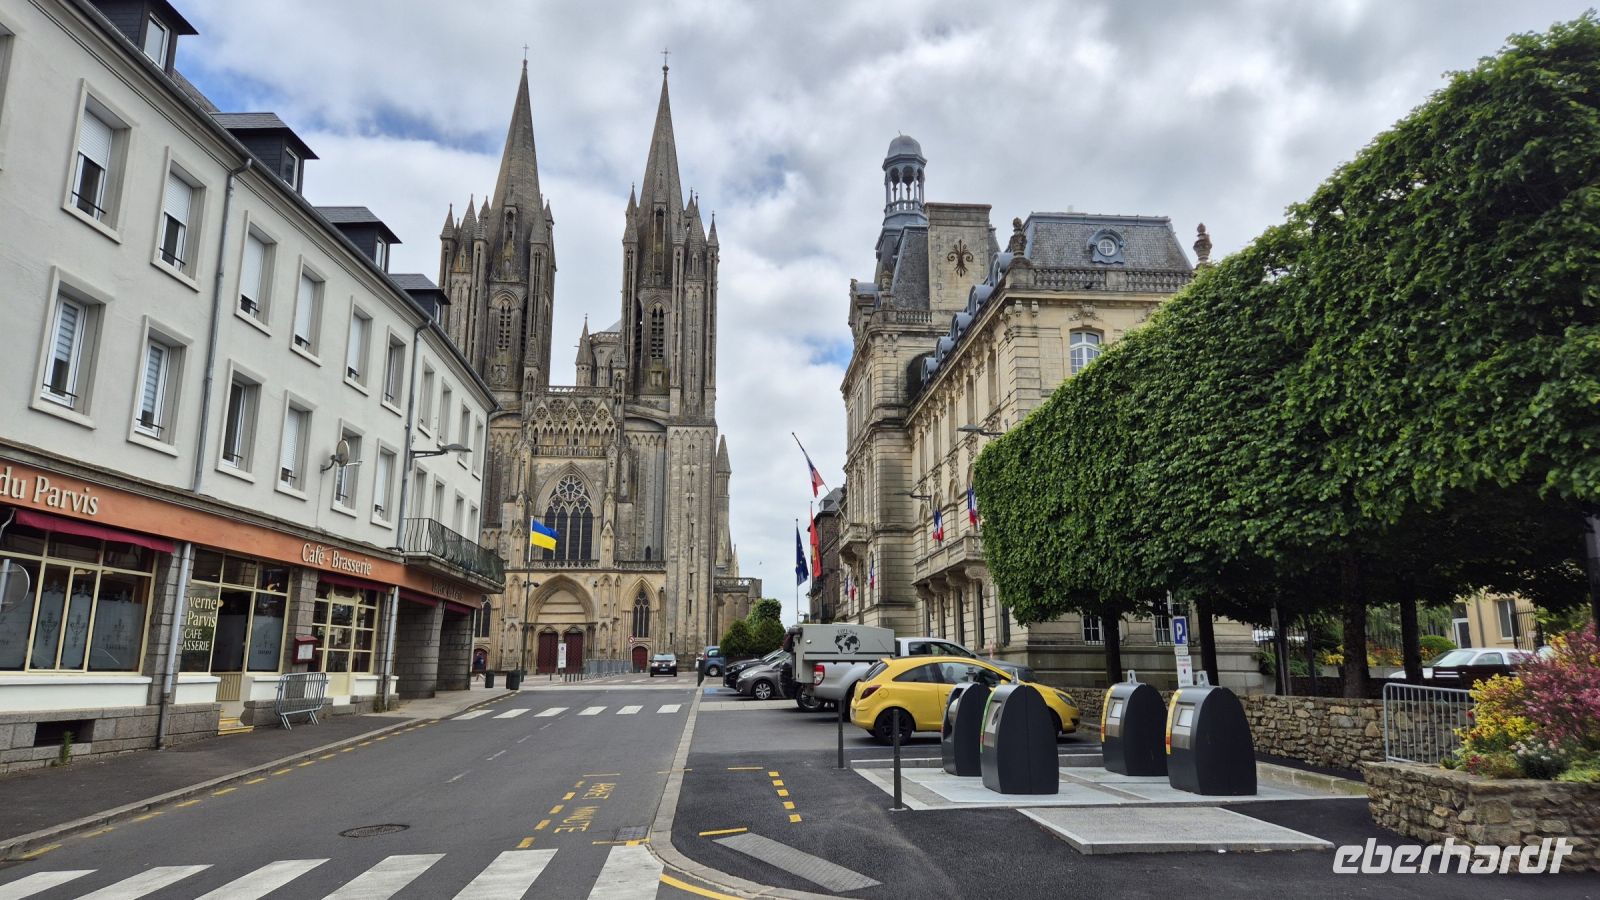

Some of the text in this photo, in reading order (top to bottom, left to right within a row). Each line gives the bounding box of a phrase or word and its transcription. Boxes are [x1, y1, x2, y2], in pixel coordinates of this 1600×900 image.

[0, 466, 98, 515] du Parvis
[302, 543, 325, 565] Café
[332, 550, 372, 575] Brasserie
[190, 597, 217, 610] verne
[187, 610, 216, 628] Parvis
[184, 628, 203, 640] CAFE
[1176, 622, 1183, 640] P
[182, 640, 210, 651] ASSERIE
